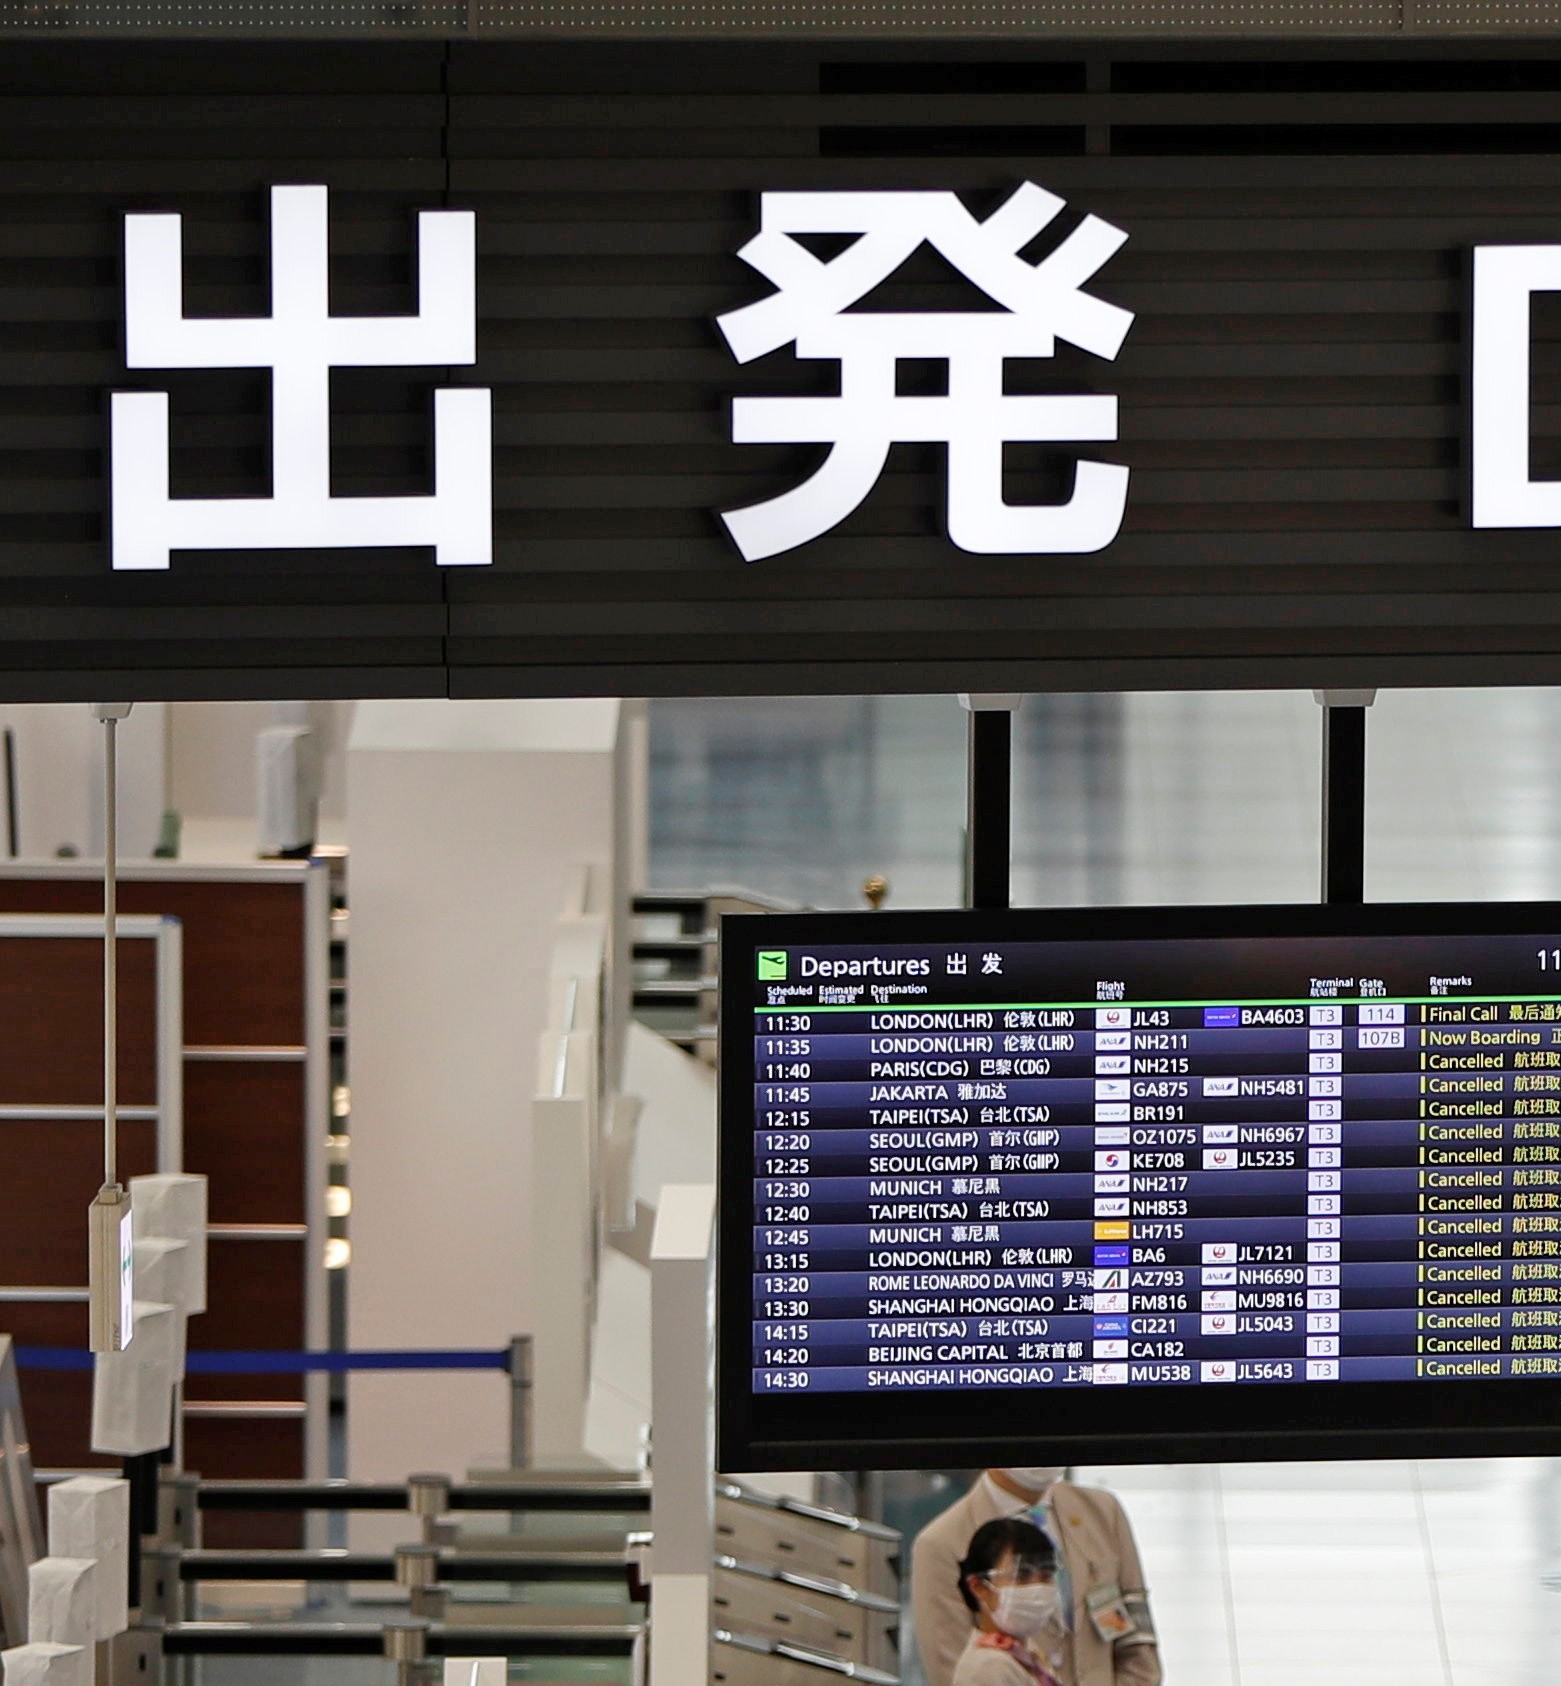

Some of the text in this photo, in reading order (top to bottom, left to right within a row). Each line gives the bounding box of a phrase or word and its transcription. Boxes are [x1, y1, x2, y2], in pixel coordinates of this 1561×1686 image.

[112, 181, 1134, 569] 出発
[801, 956, 930, 978] Departures
[870, 983, 928, 995] Destination
[1096, 980, 1125, 991] Flight
[1309, 977, 1354, 988] Terminal
[1358, 978, 1384, 988] Gate
[1429, 975, 1473, 986] Remarks
[767, 985, 812, 995] Scheduled
[818, 984, 864, 995] Estimated
[871, 1012, 994, 1030] LONDON(LHR)
[1133, 1010, 1170, 1027] JL43
[1241, 1008, 1304, 1025] BA4603
[1367, 1008, 1395, 1021] 114
[1429, 1005, 1498, 1022] Final Call
[766, 1015, 811, 1032] 11:30
[871, 1035, 993, 1054] LONDON(LHR)
[1134, 1034, 1187, 1050] NH211
[1362, 1031, 1401, 1046] 107B
[1429, 1028, 1541, 1046] Now Boarding
[870, 1059, 969, 1078] PARIS(CDG)
[1134, 1057, 1189, 1074] NH215
[1429, 1052, 1504, 1069] Cancelled
[869, 1085, 949, 1102] JAKARTA
[1133, 1081, 1188, 1098] GA875
[1240, 1079, 1304, 1096] NH5481
[869, 1107, 969, 1125] TAIPEI(TSA)
[1133, 1105, 1183, 1121] BR191
[869, 1130, 979, 1149] SEOUL(GMP)
[1132, 1128, 1197, 1145] OZ1075
[1240, 1126, 1305, 1143] NH6967
[869, 1154, 979, 1173] SEOUL(GMP)
[1133, 1152, 1185, 1168] KE708
[1239, 1150, 1295, 1167] JL5235
[870, 1179, 942, 1196] MUNICH
[1133, 1176, 1188, 1192] NH217
[868, 1201, 968, 1220] TAIPEI(TSA)
[1132, 1199, 1188, 1216] NH853
[869, 1227, 942, 1244] MUNICH
[1132, 1223, 1184, 1240] LH715
[869, 1249, 992, 1268] LONDON(LHR)
[1132, 1247, 1166, 1263] BA6
[1238, 1245, 1292, 1262] JL7121
[868, 1272, 1054, 1291] ROME LEONARDO DA VINCI
[1131, 1270, 1184, 1287] AZ793
[1239, 1268, 1304, 1285] NH6690
[868, 1296, 1054, 1315] SHANGHAI HONGQIAO
[1132, 1294, 1187, 1311] FM816
[1238, 1292, 1304, 1309] MU9816
[867, 1320, 967, 1339] TAIPEI(TSA)
[1131, 1318, 1175, 1334] CI221
[1237, 1315, 1294, 1333] JL5043
[868, 1344, 1009, 1362] BEIJING CAPITAL
[1130, 1341, 1184, 1358] CA182
[868, 1367, 1054, 1387] SHANGHAI HONGQIAO
[1131, 1364, 1191, 1382] MU538
[1237, 1362, 1293, 1380] JL5643
